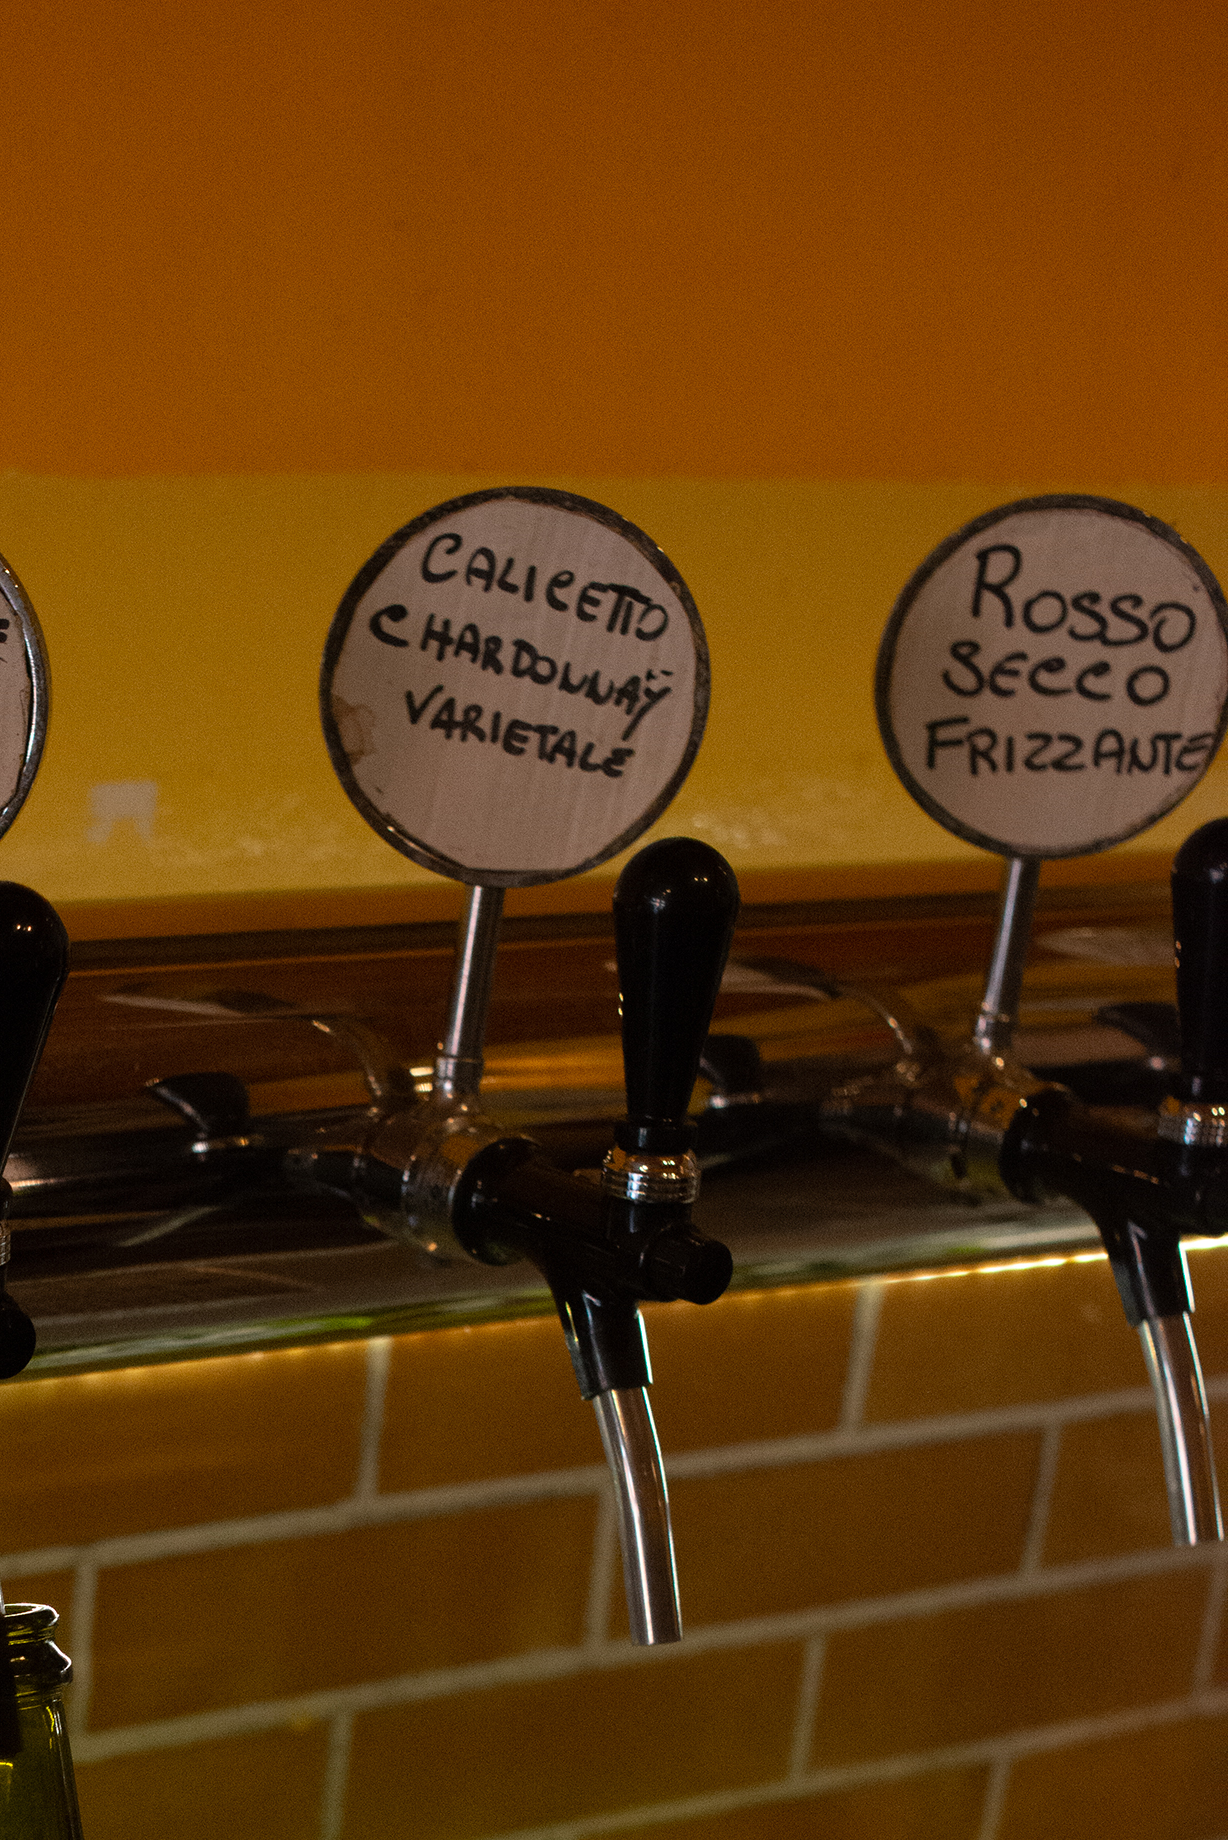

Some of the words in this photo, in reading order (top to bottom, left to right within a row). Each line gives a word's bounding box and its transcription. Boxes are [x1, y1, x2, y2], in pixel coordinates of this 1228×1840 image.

[420, 532, 669, 641] CALICETTO
[971, 543, 1197, 653] ROSSO
[942, 640, 1171, 706] SECCO
[404, 684, 636, 778] VARIETALE
[925, 716, 1217, 777] FRIZZANTE
